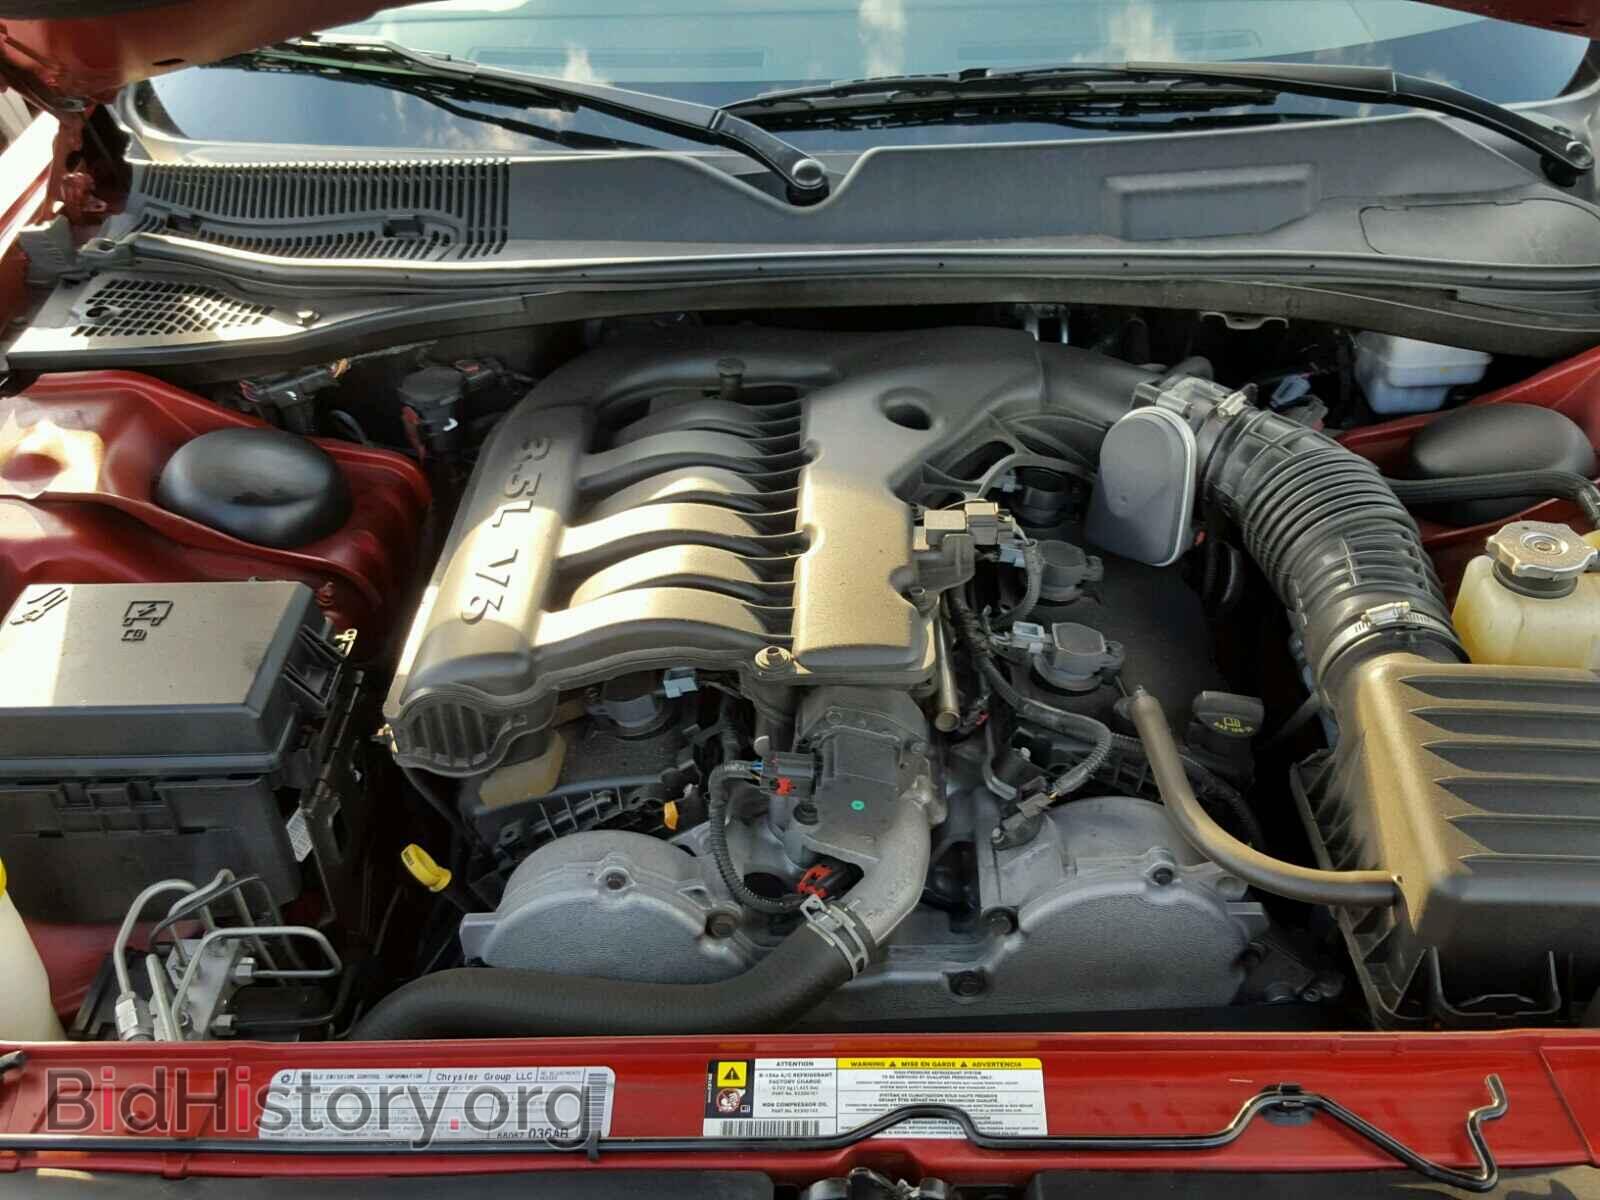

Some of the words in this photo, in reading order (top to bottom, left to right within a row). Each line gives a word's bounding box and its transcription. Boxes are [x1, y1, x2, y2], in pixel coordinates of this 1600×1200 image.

[460, 548, 519, 625] V6
[436, 1072, 479, 1083] Chrysler
[484, 1072, 512, 1083] Group
[516, 1072, 533, 1081] LLC
